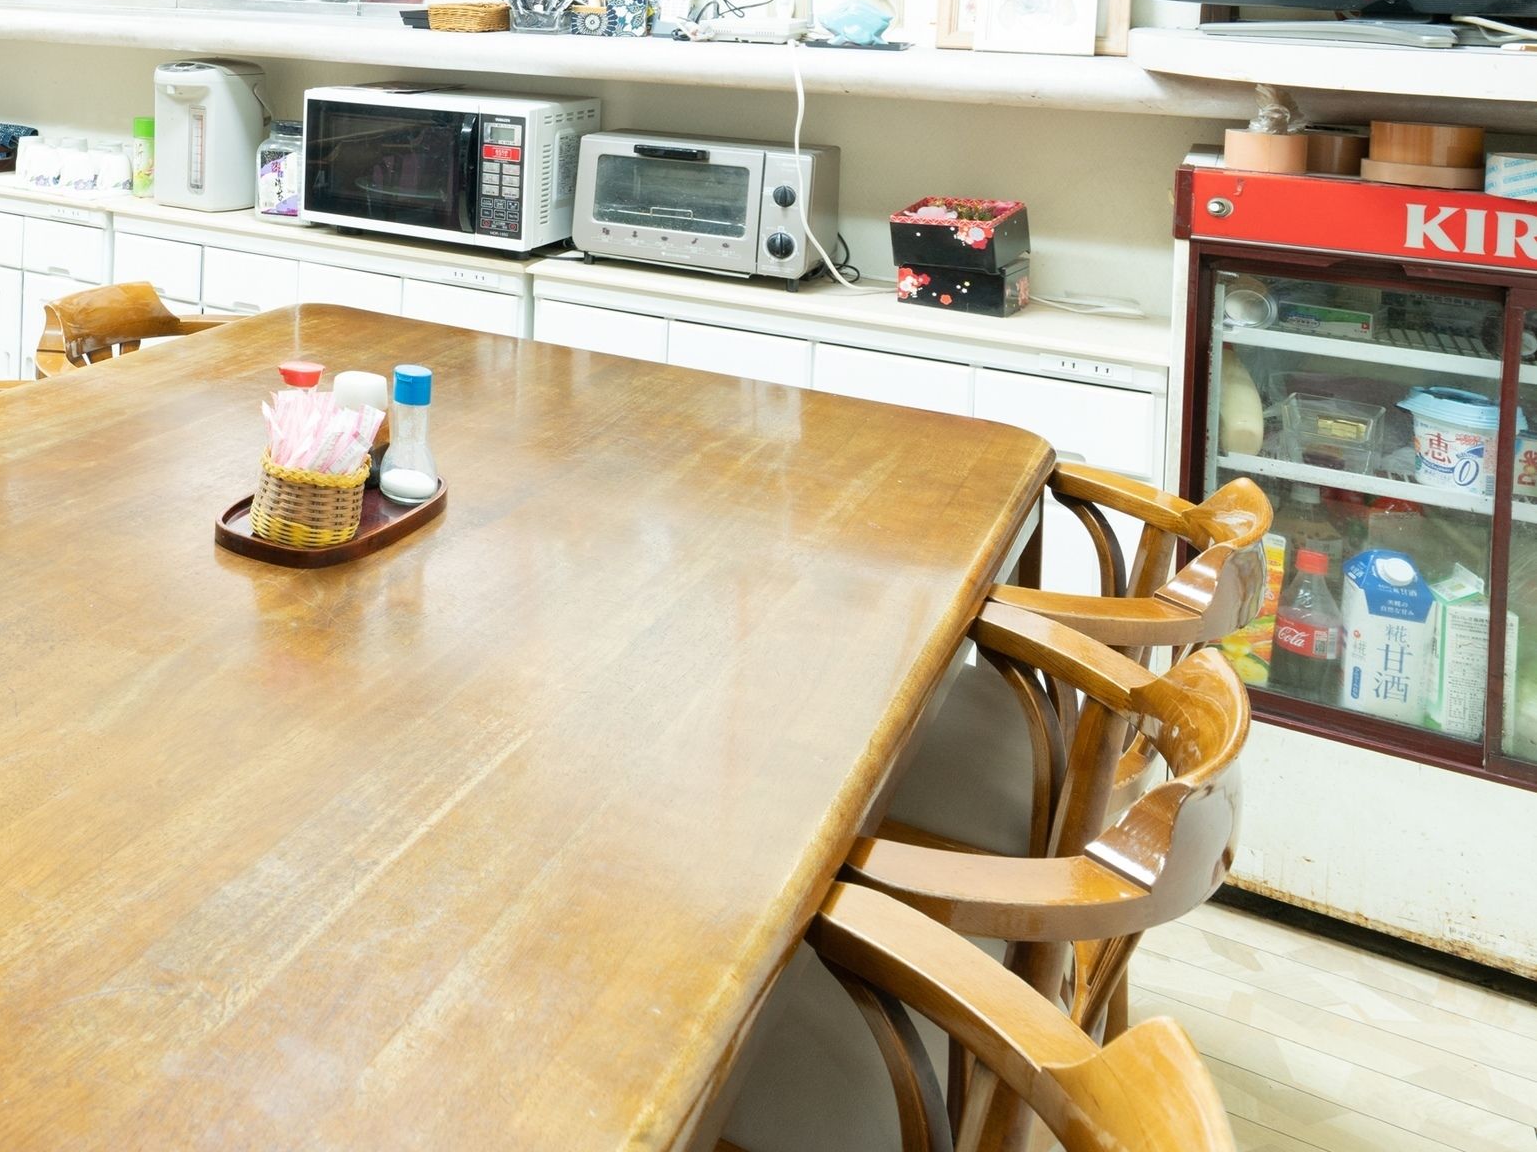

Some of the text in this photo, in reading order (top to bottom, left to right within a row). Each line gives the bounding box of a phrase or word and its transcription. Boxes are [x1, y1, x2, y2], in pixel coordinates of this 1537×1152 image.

[1404, 203, 1537, 260] KIR
[1373, 623, 1413, 703] 糀甘酒
